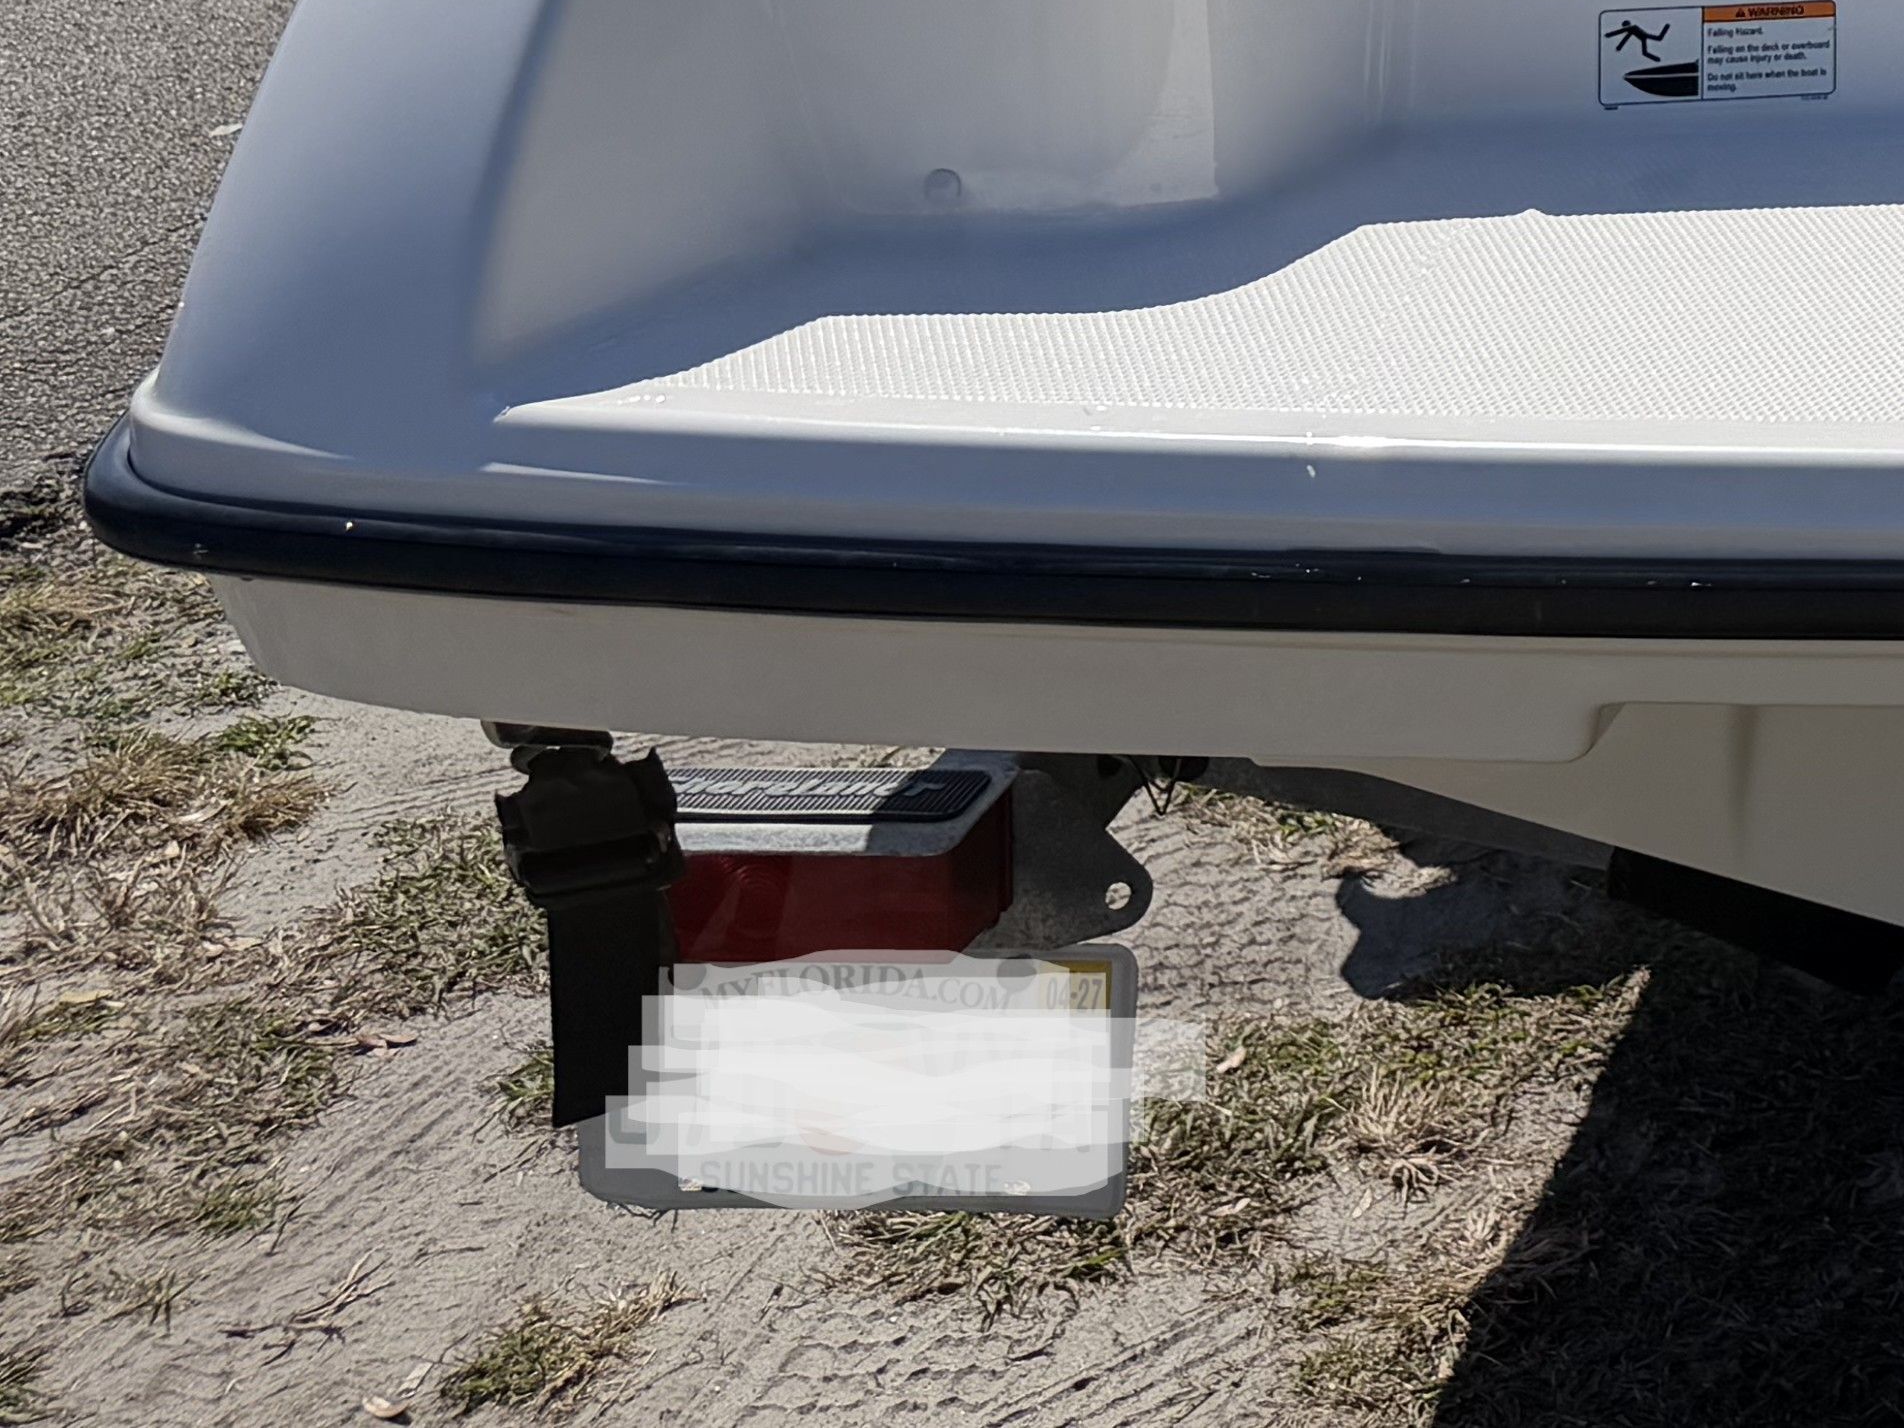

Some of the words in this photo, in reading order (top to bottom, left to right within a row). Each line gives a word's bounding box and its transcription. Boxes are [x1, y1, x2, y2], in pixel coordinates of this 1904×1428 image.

[1748, 5, 1806, 18] WARNING
[699, 1160, 876, 1196] SUNSHINE
[892, 1163, 1004, 1197] STATE
